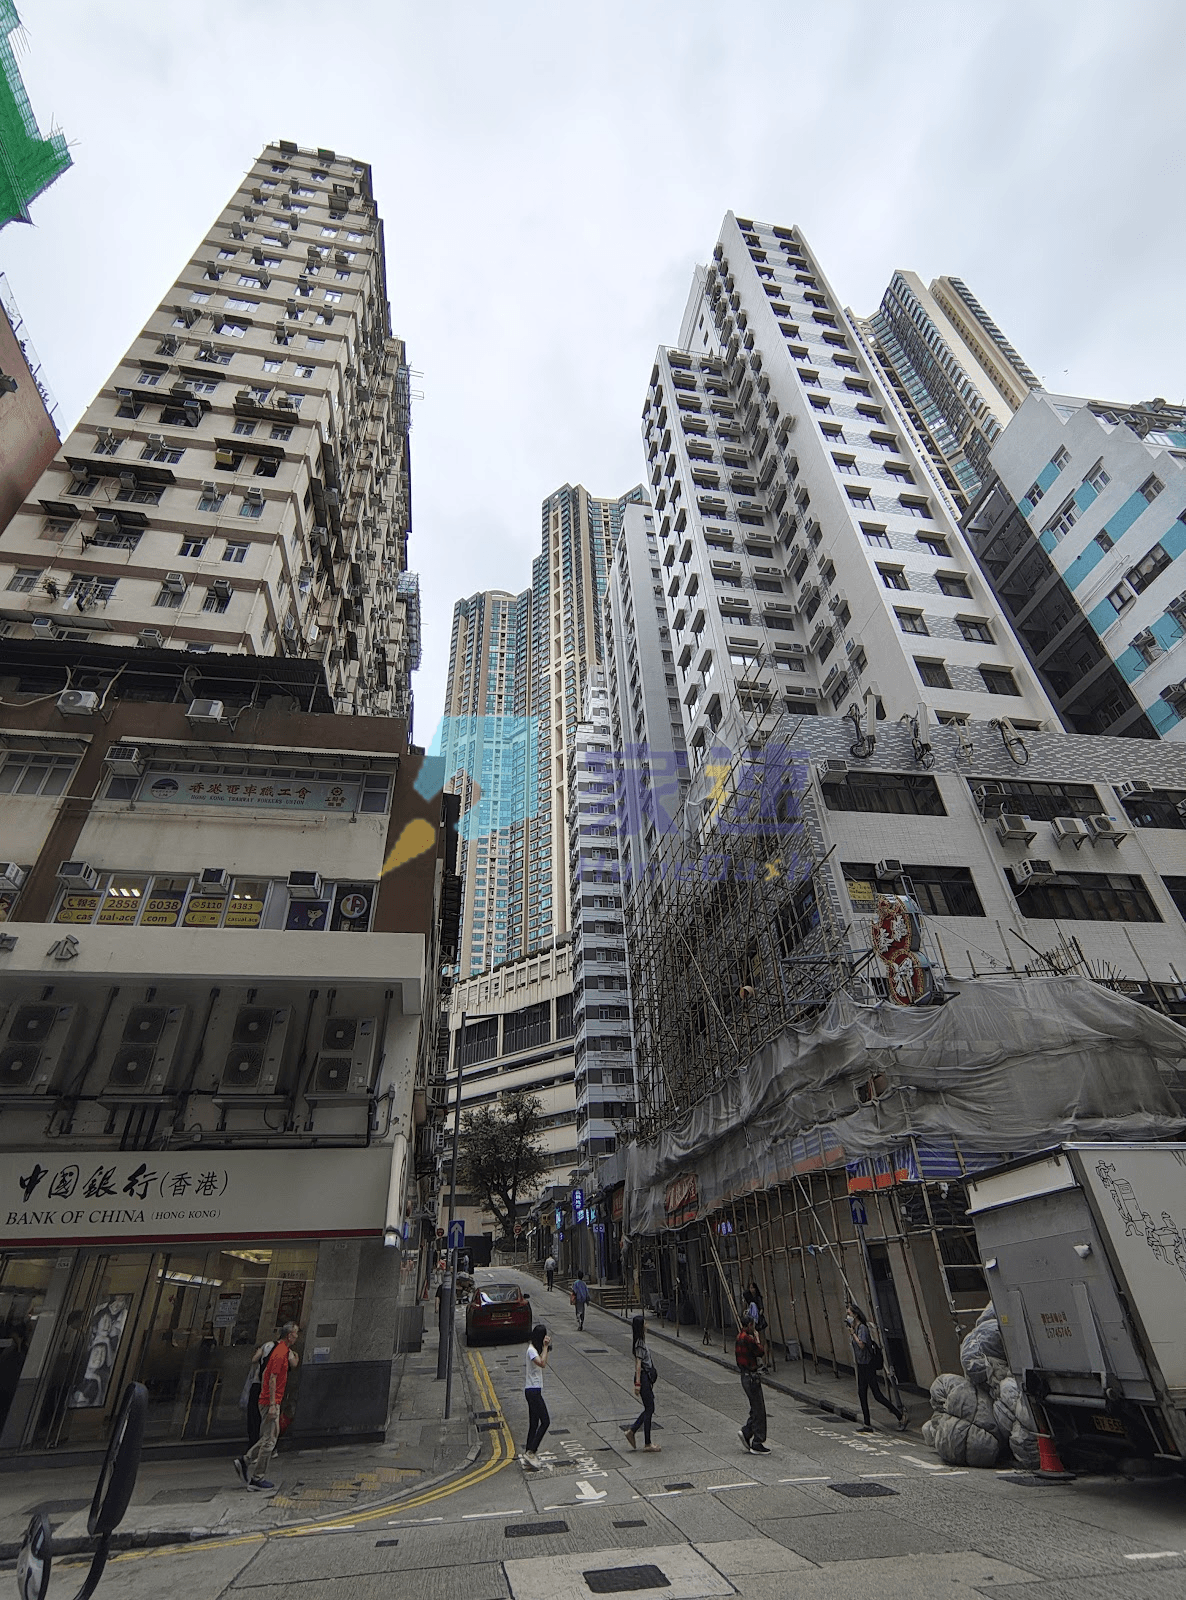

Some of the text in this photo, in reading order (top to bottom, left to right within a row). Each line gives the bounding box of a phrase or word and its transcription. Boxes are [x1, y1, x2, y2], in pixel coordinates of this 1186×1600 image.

[107, 899, 139, 909] 2858
[149, 900, 180, 910] 6038
[200, 901, 253, 910] 5110 4383
[6, 1209, 222, 1226] BANK OF CHINA (HONG KONG)
[559, 1439, 587, 1458] LOOK
